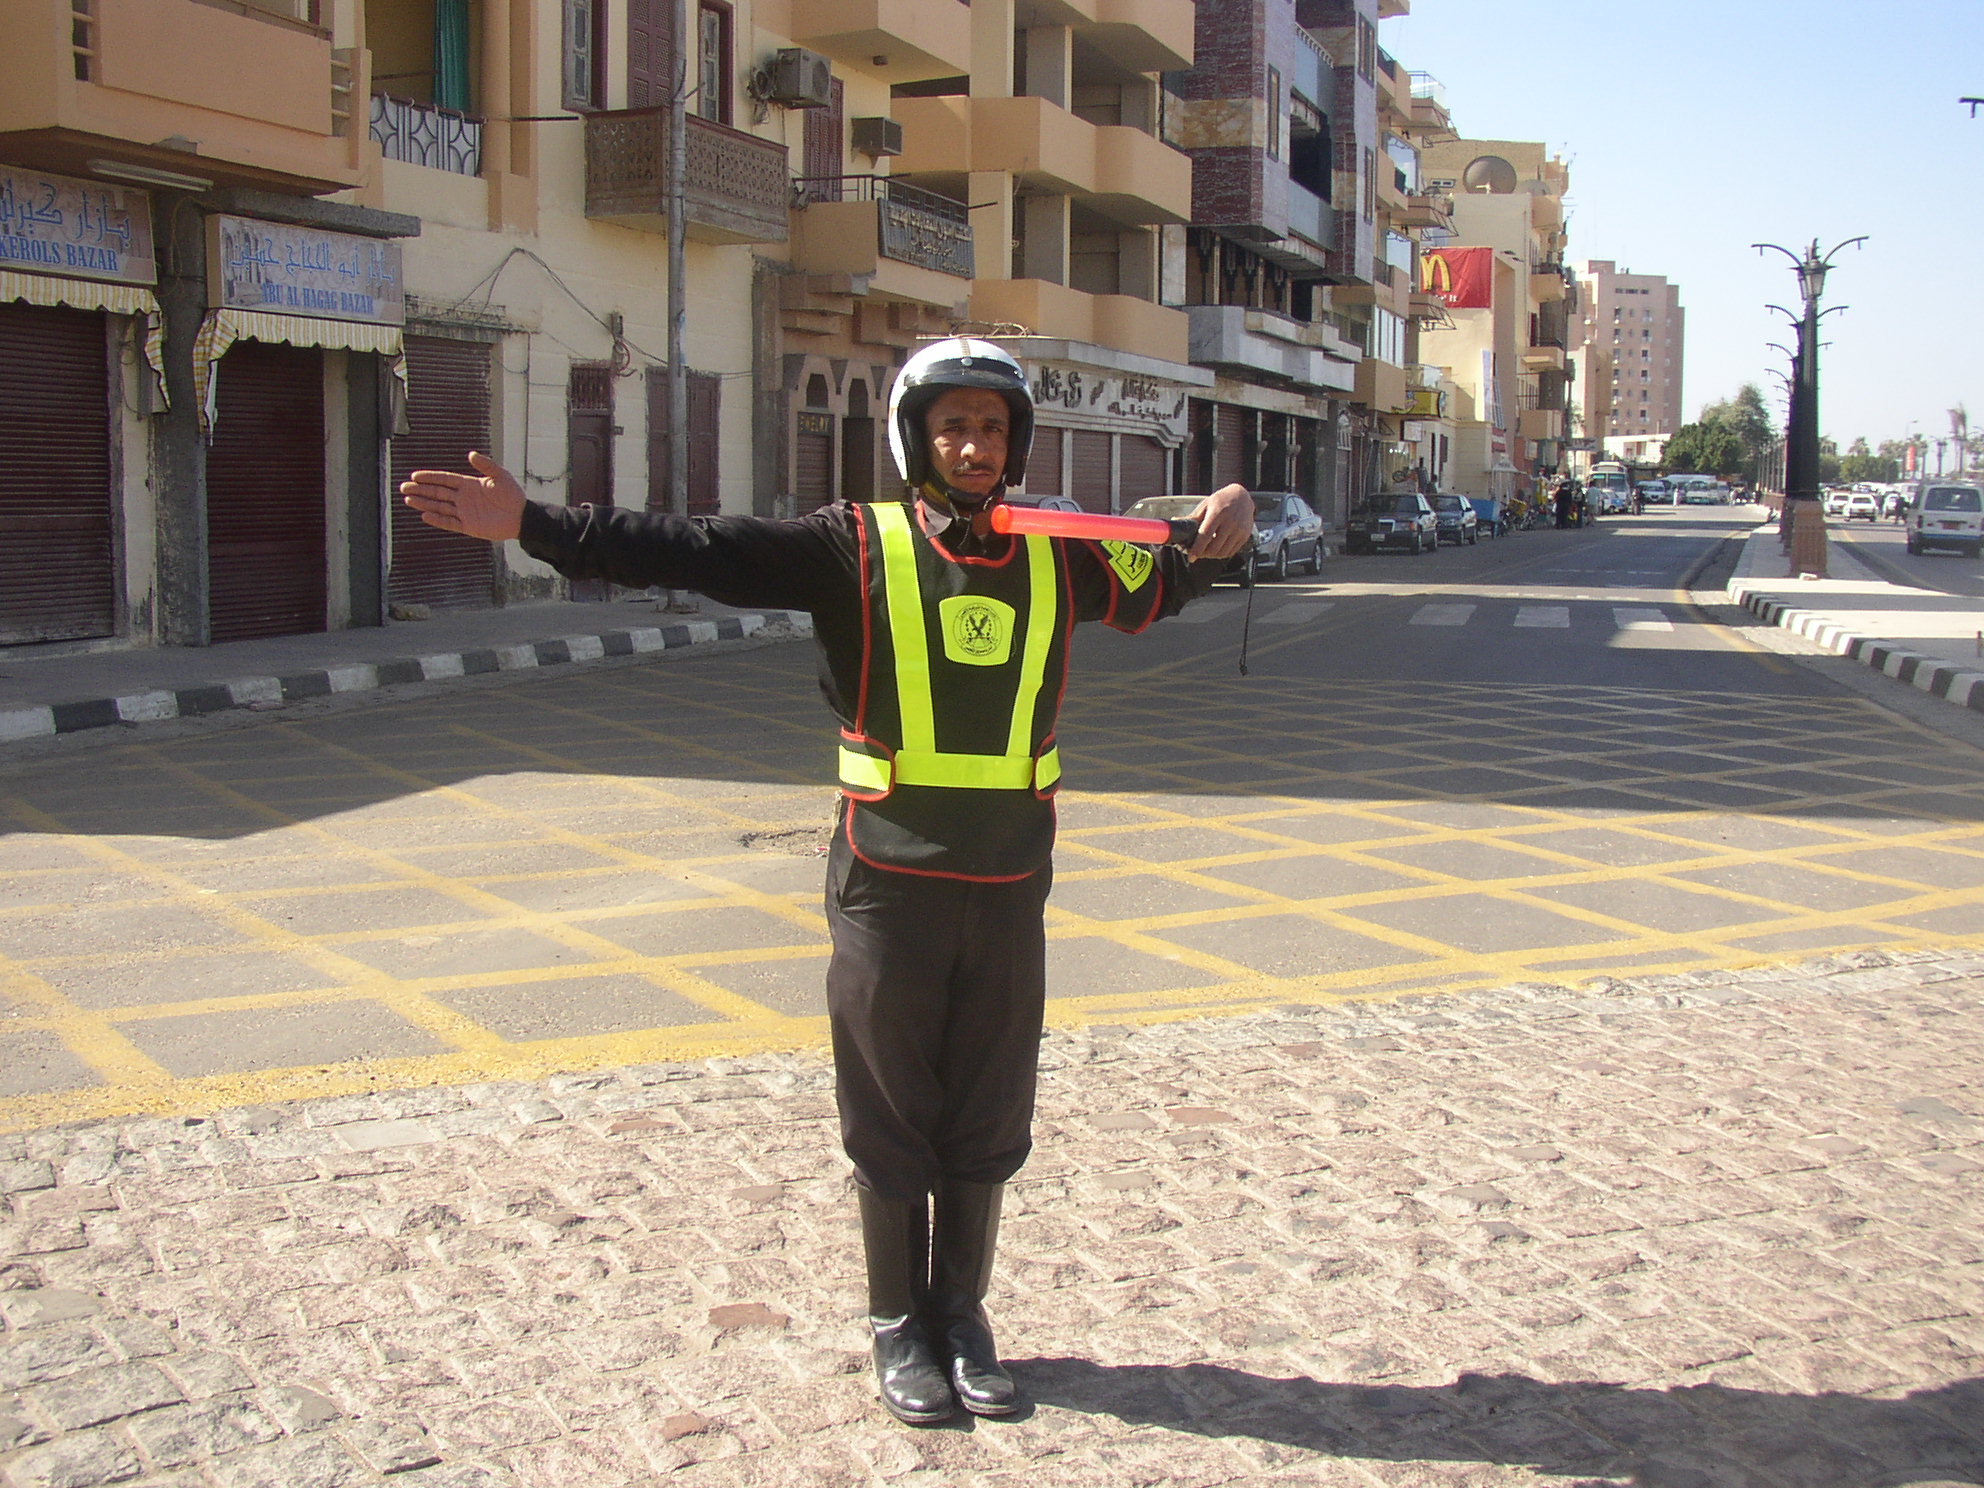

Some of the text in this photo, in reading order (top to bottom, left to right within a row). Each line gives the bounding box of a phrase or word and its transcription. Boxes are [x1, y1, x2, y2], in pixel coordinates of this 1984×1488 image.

[65, 243, 119, 272] BAZAR
[262, 282, 375, 315] ABU AL HAGAG BAZAR
